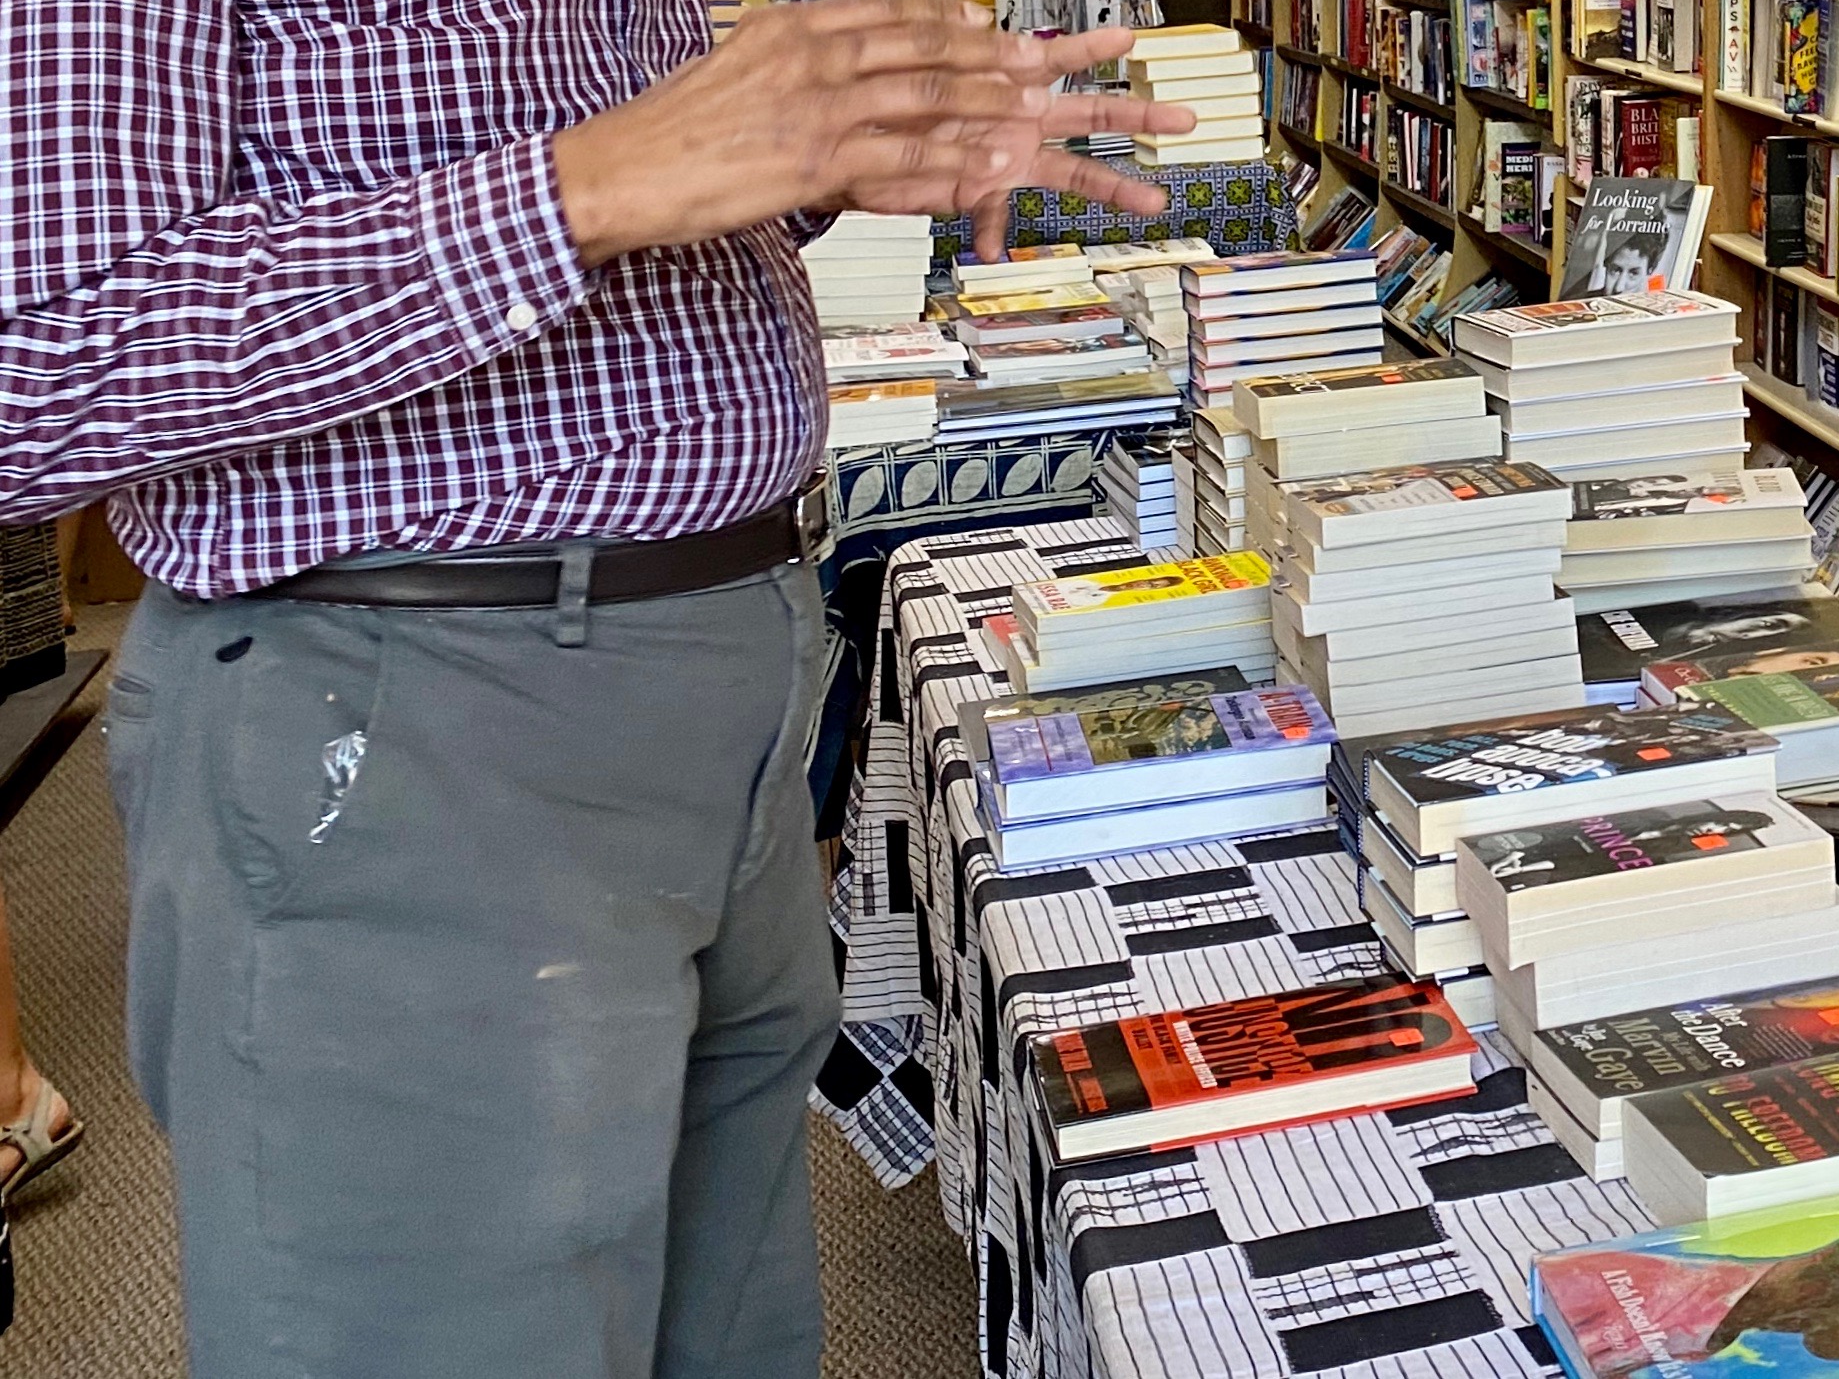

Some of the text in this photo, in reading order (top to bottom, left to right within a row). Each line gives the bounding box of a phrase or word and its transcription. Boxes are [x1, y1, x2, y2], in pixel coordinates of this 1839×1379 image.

[1592, 187, 1659, 217] Looking
[1582, 216, 1671, 235] for Lorraine
[1701, 1002, 1748, 1028] After
[1607, 1017, 1686, 1076] Marvin
[1683, 1021, 1747, 1069] Dance
[1585, 1047, 1645, 1092] Gaye
